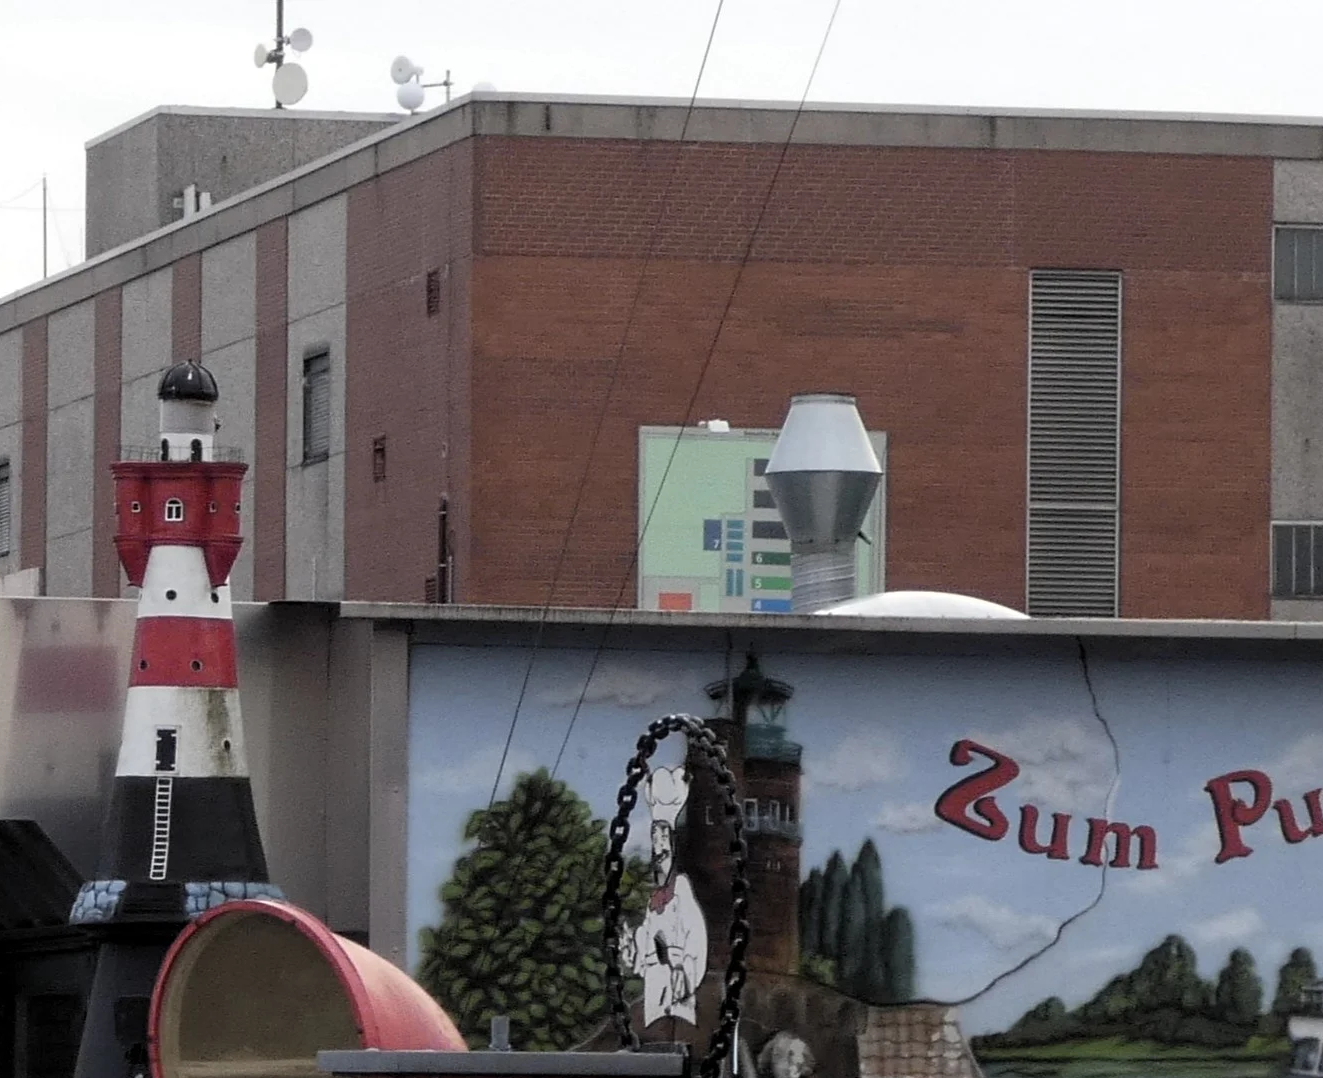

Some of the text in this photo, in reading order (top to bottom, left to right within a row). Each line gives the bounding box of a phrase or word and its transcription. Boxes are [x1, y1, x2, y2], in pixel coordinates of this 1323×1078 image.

[755, 553, 763, 563] 6
[754, 578, 762, 588] 5
[934, 739, 1159, 869] Zum
